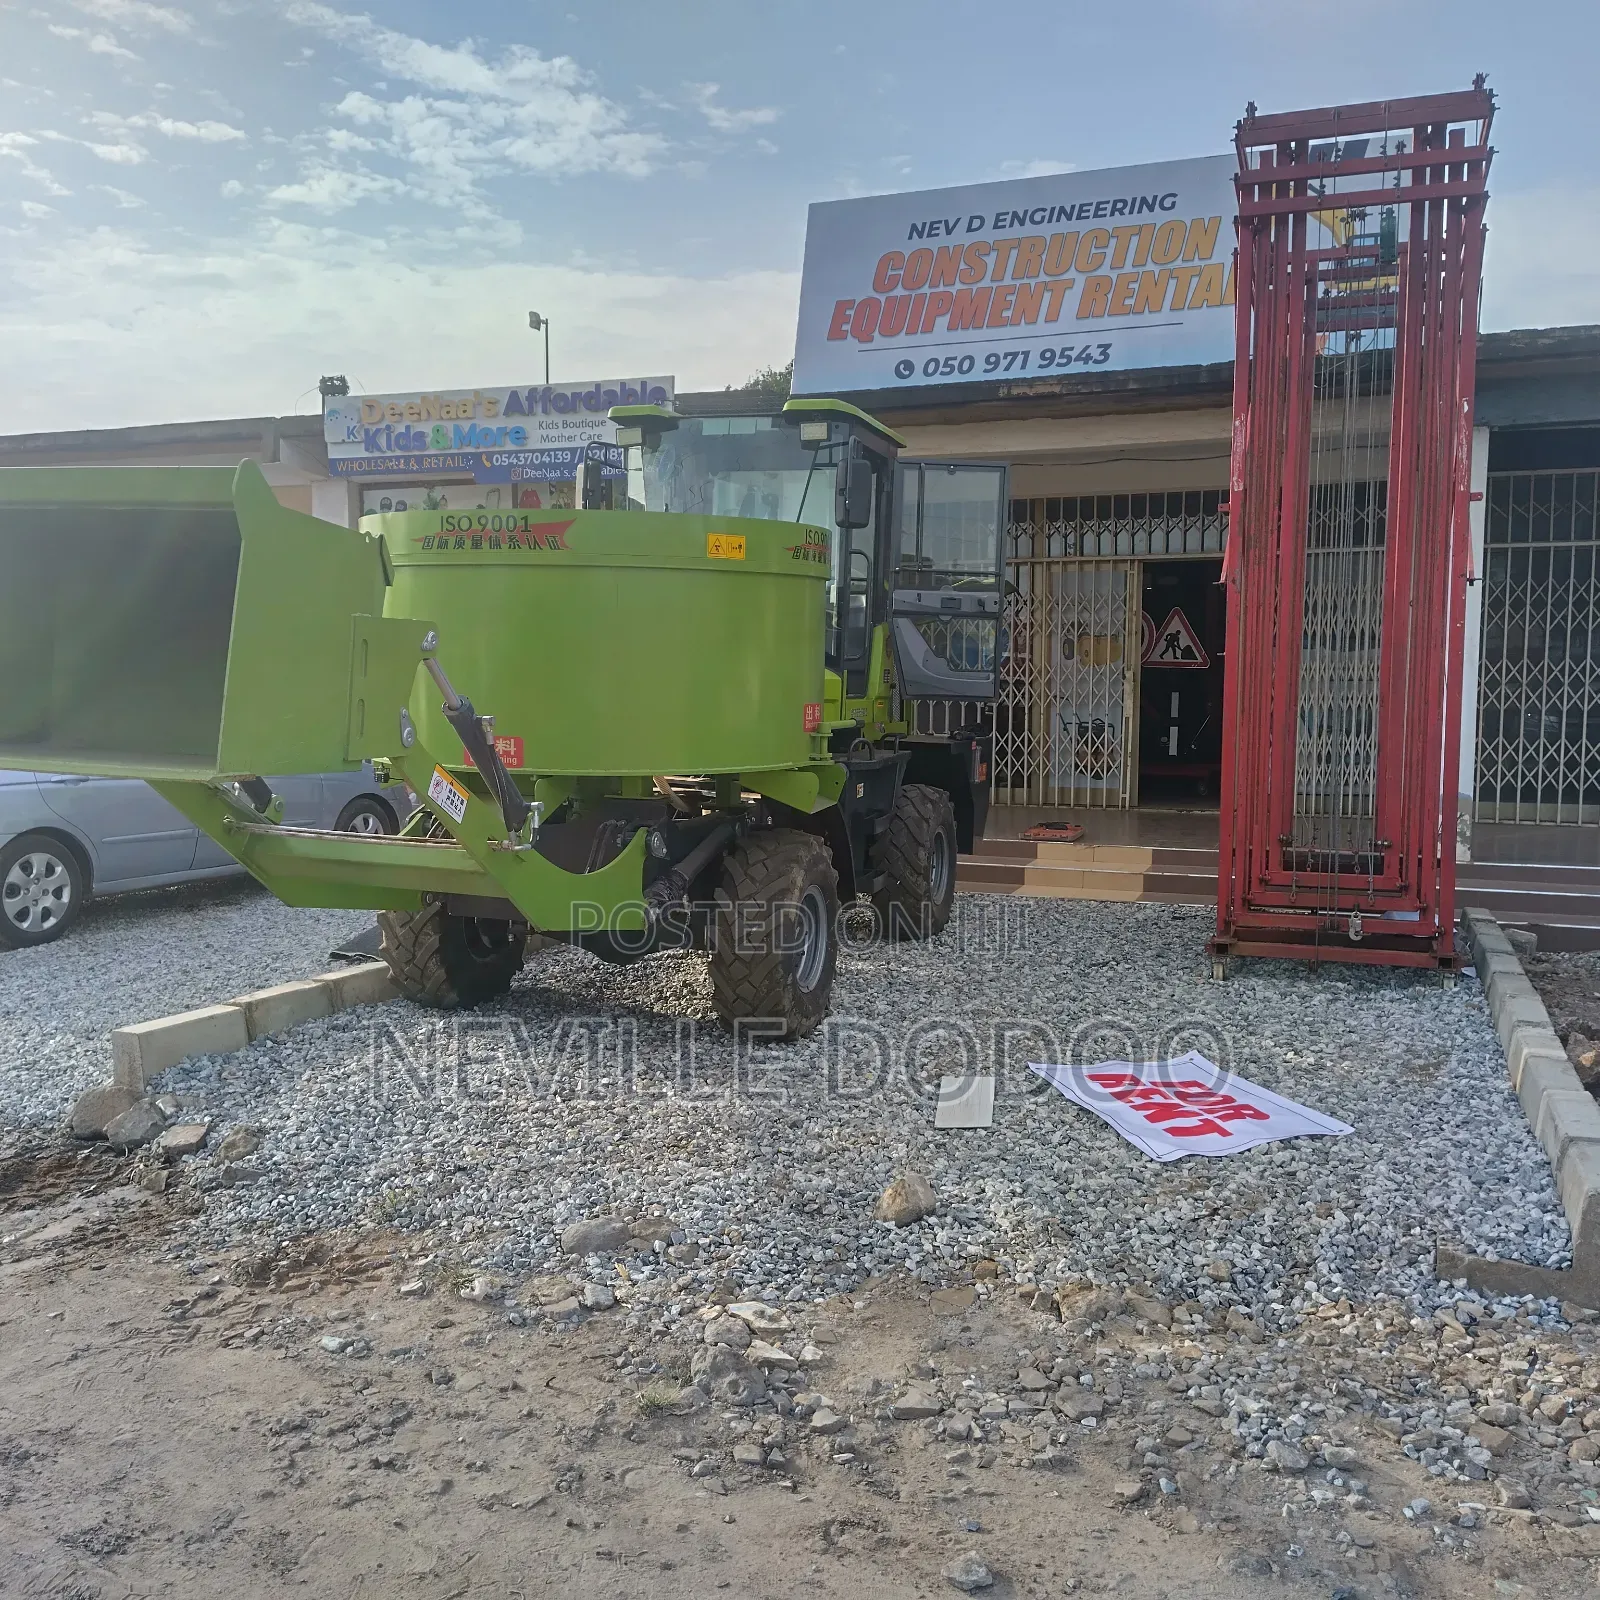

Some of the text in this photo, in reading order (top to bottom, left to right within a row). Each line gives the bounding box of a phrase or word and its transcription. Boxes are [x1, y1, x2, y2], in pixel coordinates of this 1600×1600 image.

[908, 193, 1178, 240] NEV D ENGINEERING
[872, 216, 1222, 293] CONSTRUCTION
[826, 279, 1074, 342] EQUIPMENT
[922, 343, 1112, 377] 050 971 9543
[362, 380, 668, 425] DeeNaa's Affordable
[538, 418, 607, 431] Kids Boutique
[540, 432, 603, 444] Mother Care
[337, 455, 466, 472] WHOLESALE & RETAIL
[493, 451, 571, 466] 0543704139
[441, 515, 532, 533] ISO 9001
[422, 535, 564, 551] 国际质量体系认证
